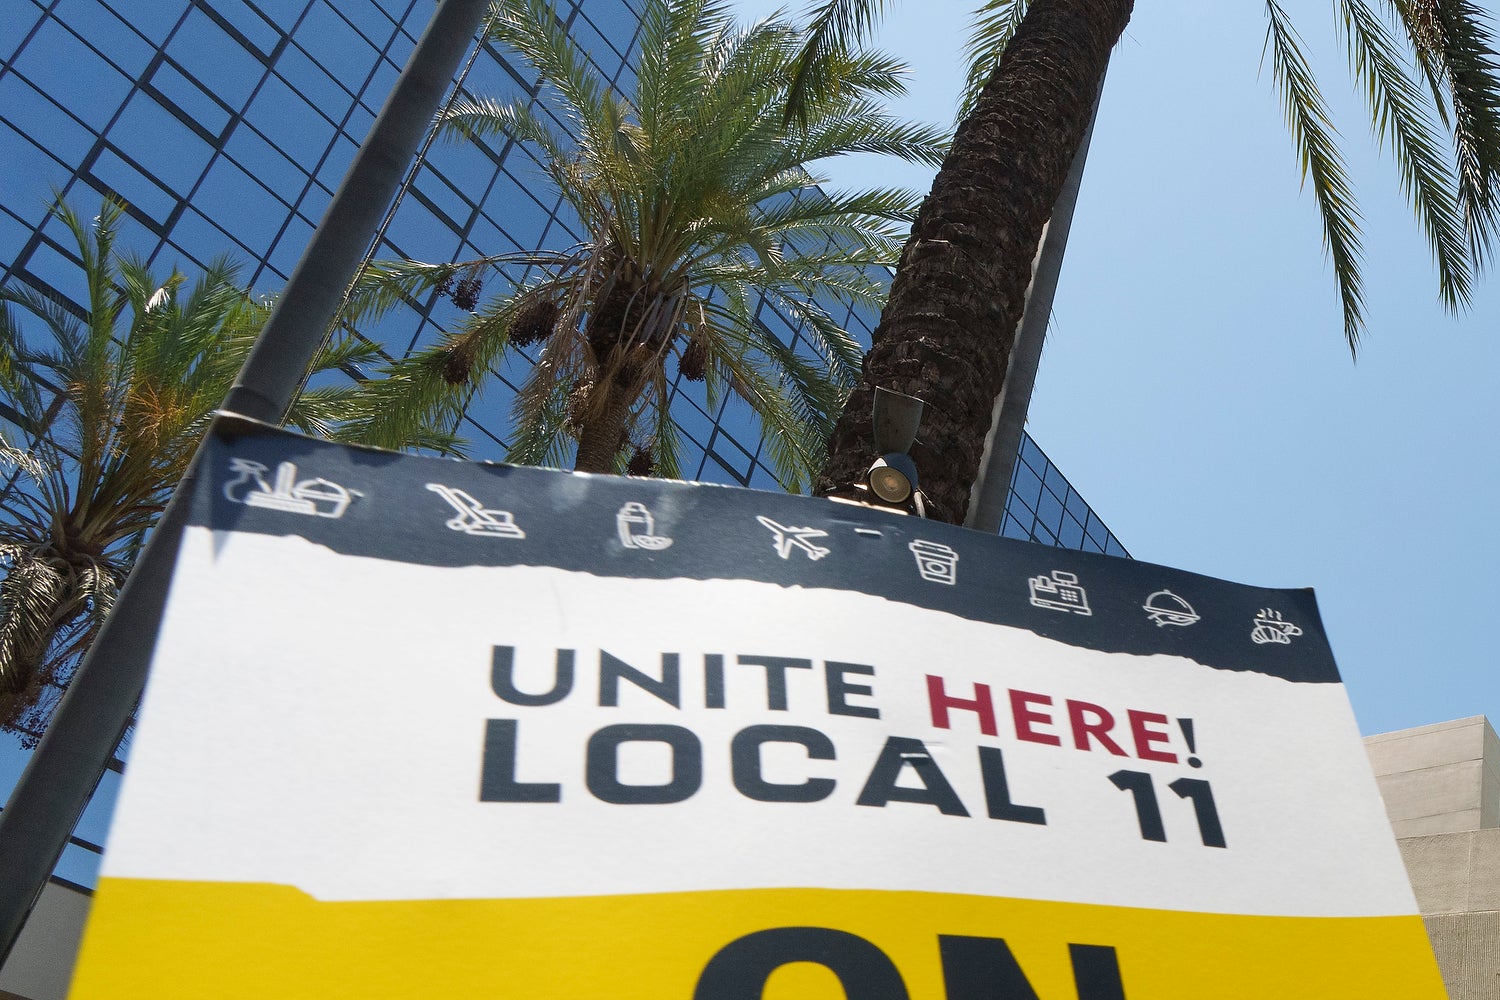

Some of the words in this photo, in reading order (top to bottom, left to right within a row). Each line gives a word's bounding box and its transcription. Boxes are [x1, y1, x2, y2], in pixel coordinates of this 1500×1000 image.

[491, 645, 880, 720] UNITE
[925, 673, 1204, 768] HERE!
[479, 718, 1047, 826] LOCAL
[1108, 769, 1227, 849] 11
